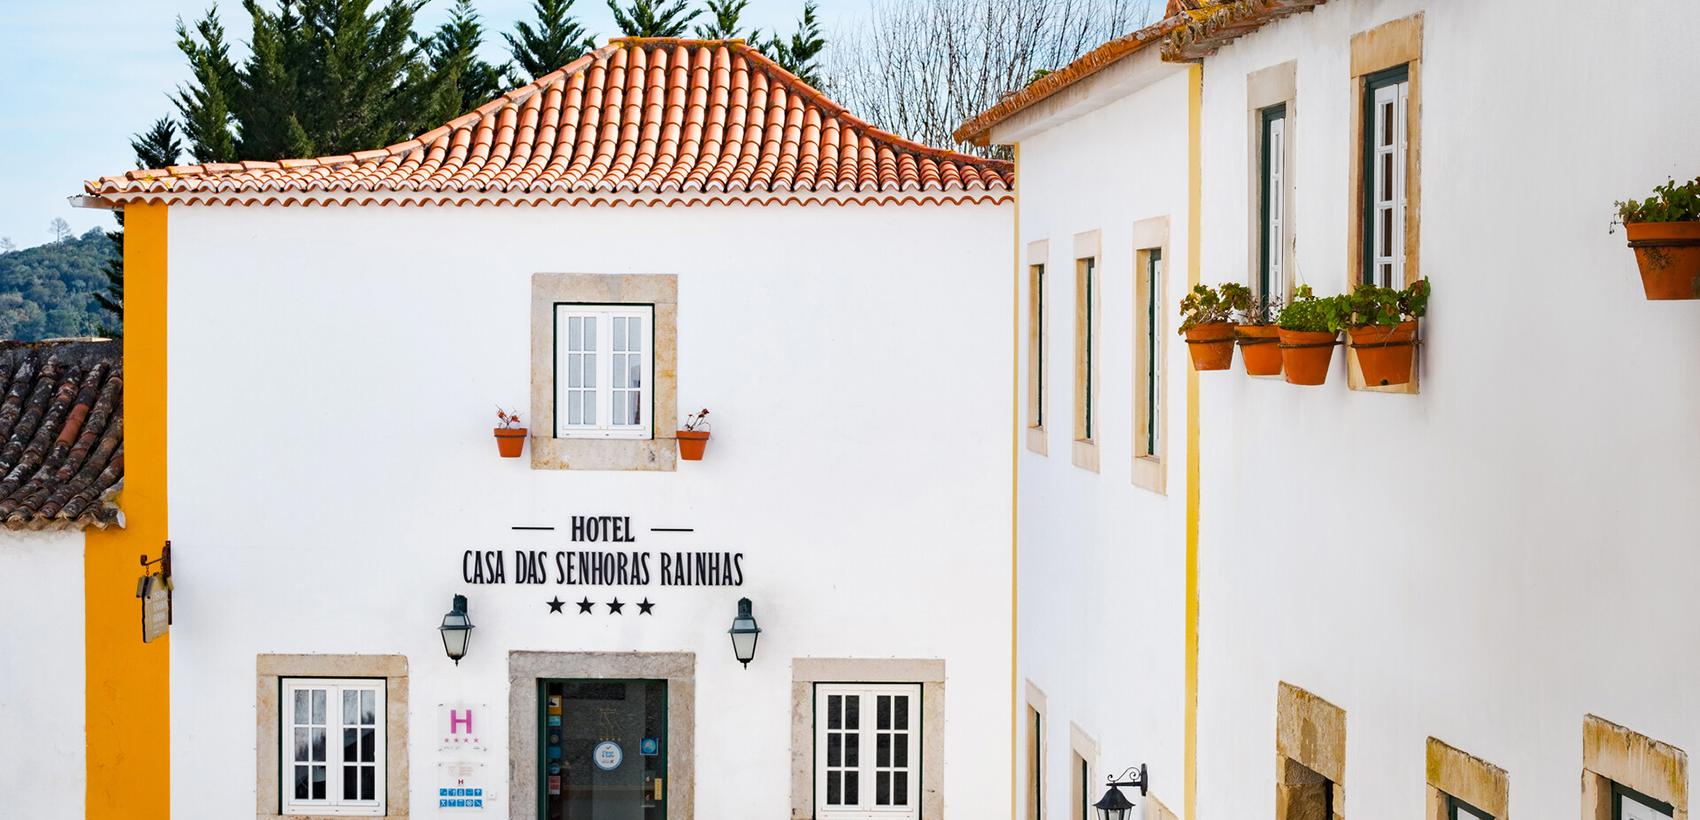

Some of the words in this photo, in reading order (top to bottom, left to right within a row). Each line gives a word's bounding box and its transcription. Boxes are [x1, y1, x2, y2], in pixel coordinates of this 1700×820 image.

[571, 515, 636, 543] HOTEL
[462, 549, 506, 585] CASA
[515, 550, 548, 585] DAS
[556, 551, 650, 586] SENHORAS
[660, 552, 744, 587] RAINHAS
[450, 709, 473, 735] H
